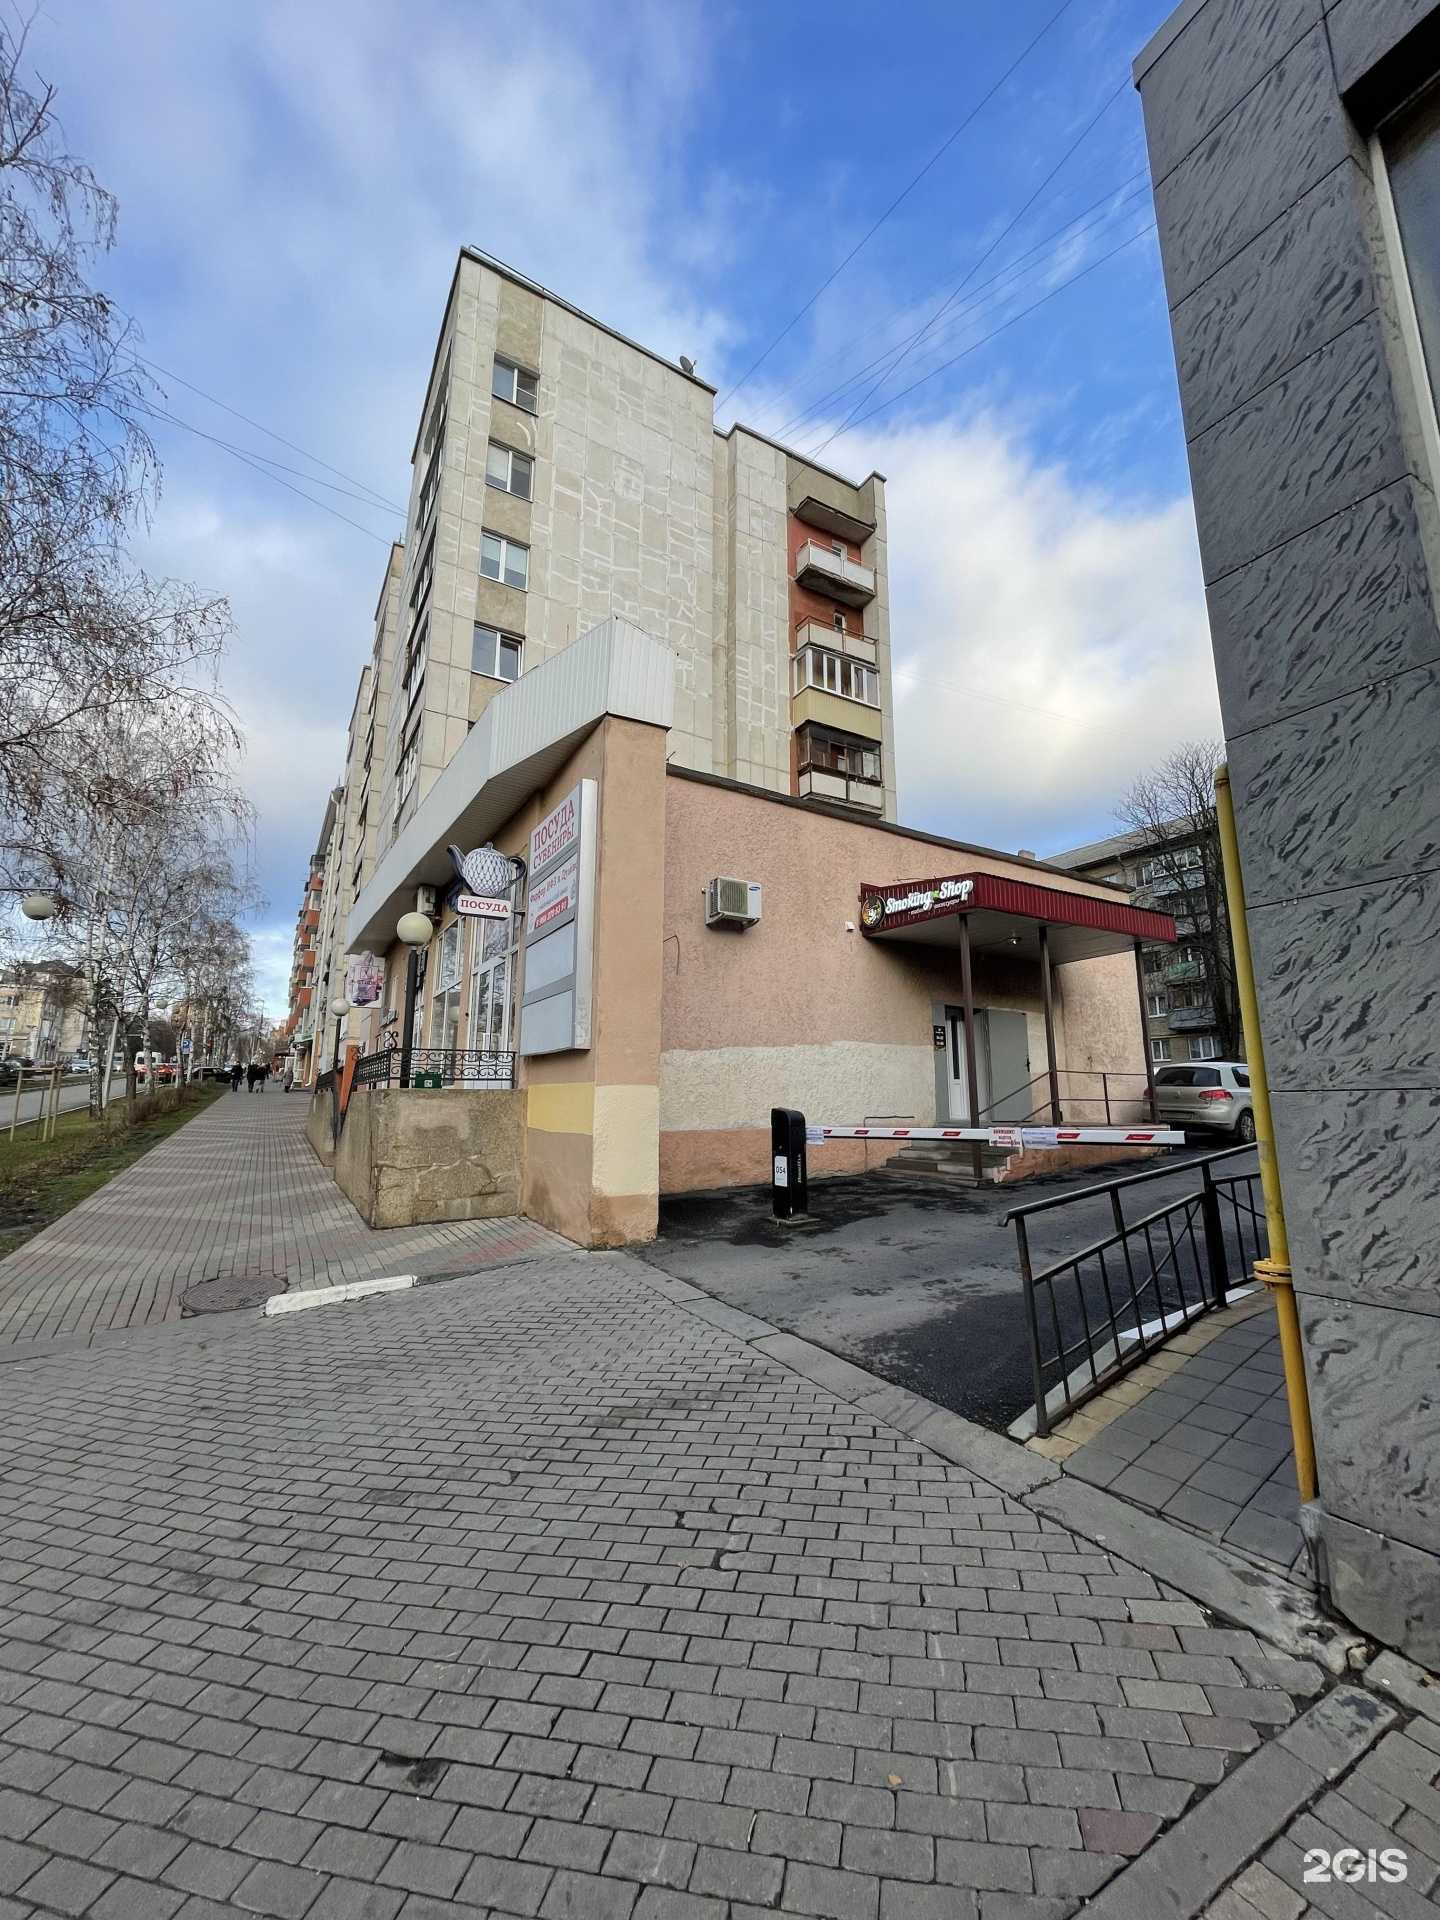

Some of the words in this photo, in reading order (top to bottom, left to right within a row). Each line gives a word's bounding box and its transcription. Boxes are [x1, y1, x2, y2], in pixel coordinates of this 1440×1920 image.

[534, 800, 574, 853] ПОСУДА
[534, 822, 574, 869] СУВЕНИРЫ
[461, 899, 509, 912] ПОСУДА
[885, 892, 934, 914] Smoking
[940, 880, 973, 900] Shop
